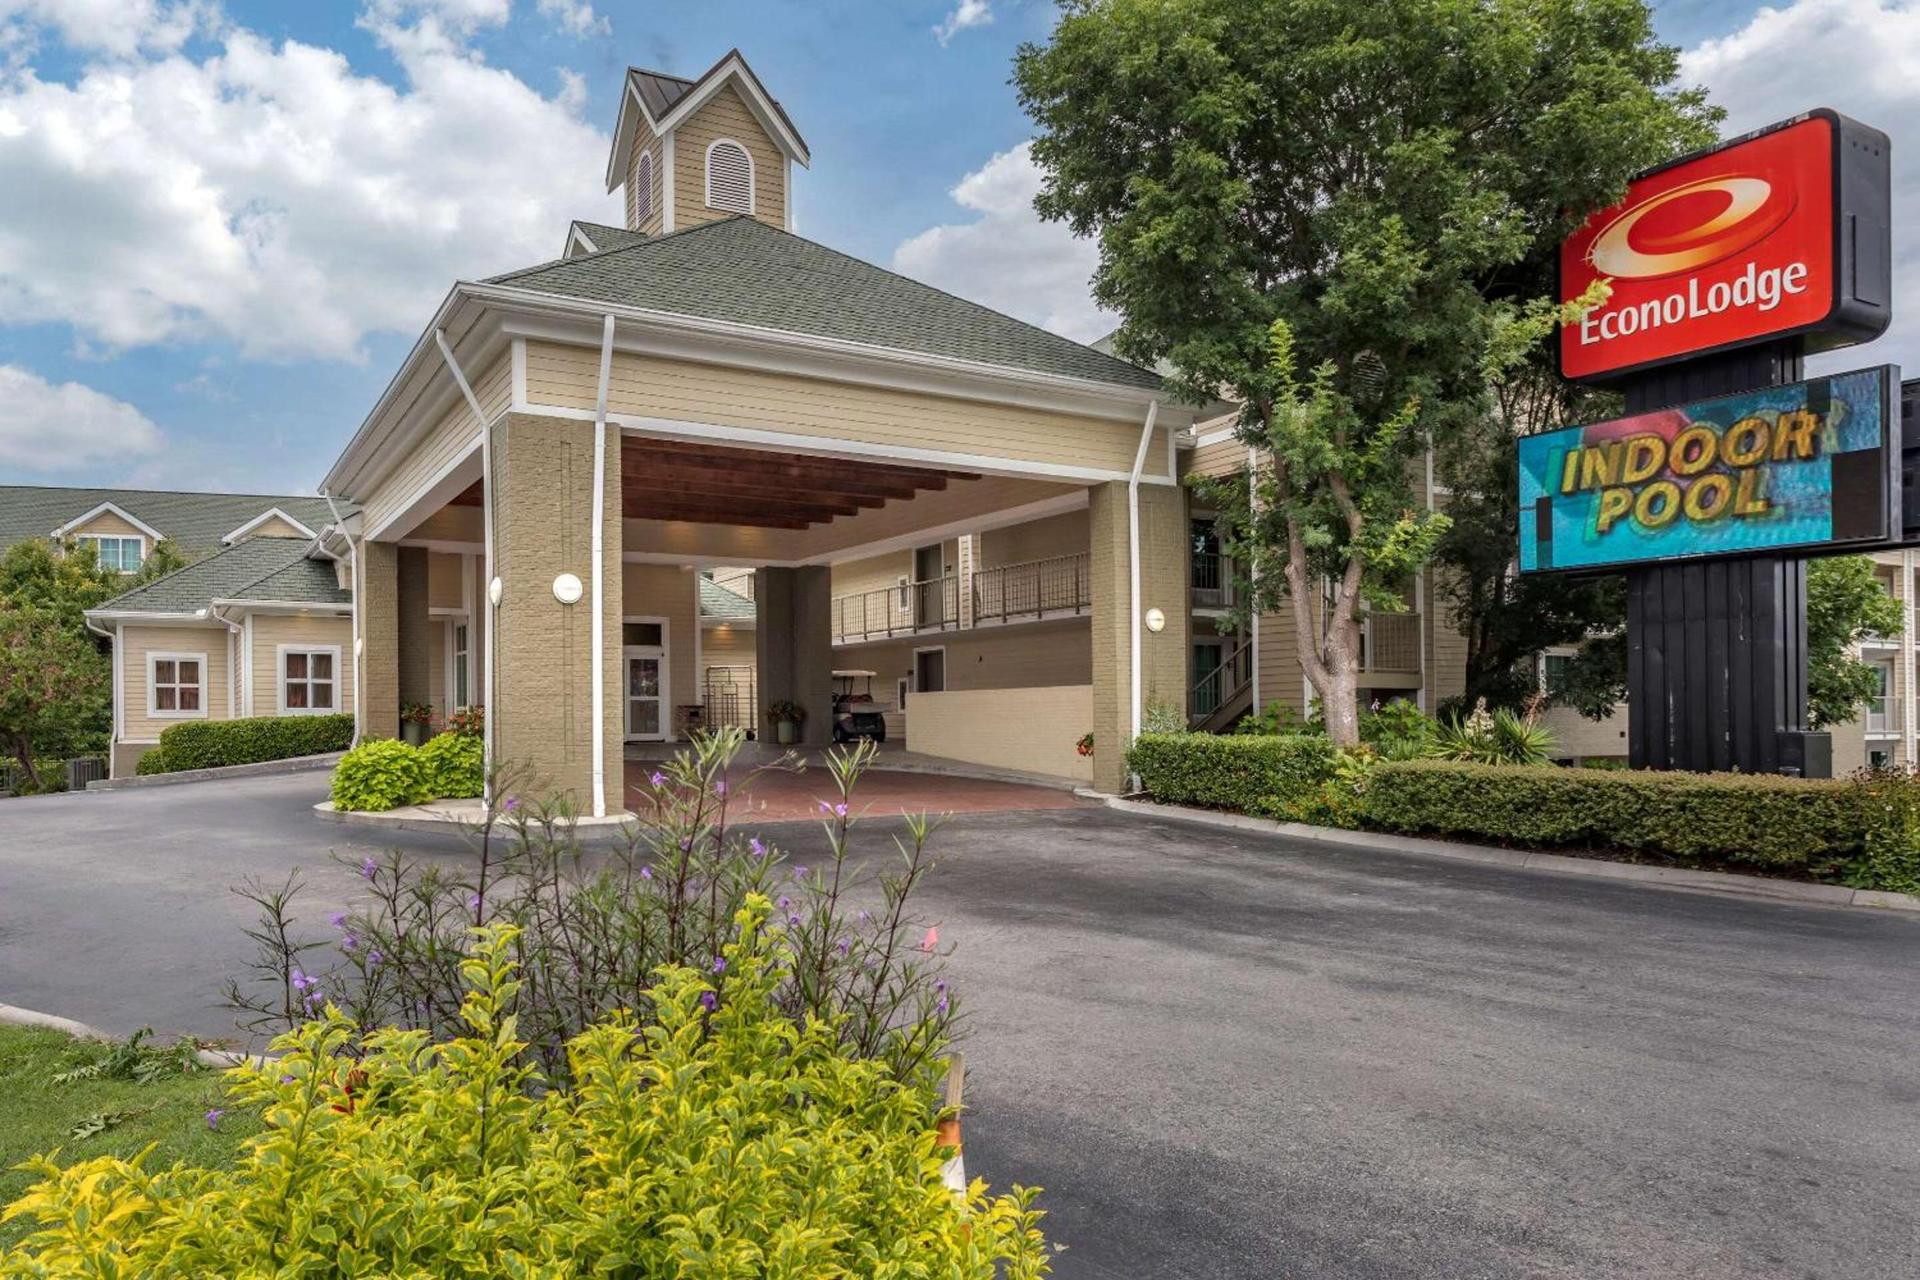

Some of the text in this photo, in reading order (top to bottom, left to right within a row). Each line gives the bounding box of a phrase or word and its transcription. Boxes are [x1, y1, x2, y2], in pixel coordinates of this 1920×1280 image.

[1580, 261, 1808, 345] EconoLodge
[1561, 409, 1820, 493] INDOOR
[1595, 468, 1774, 533] POOL
